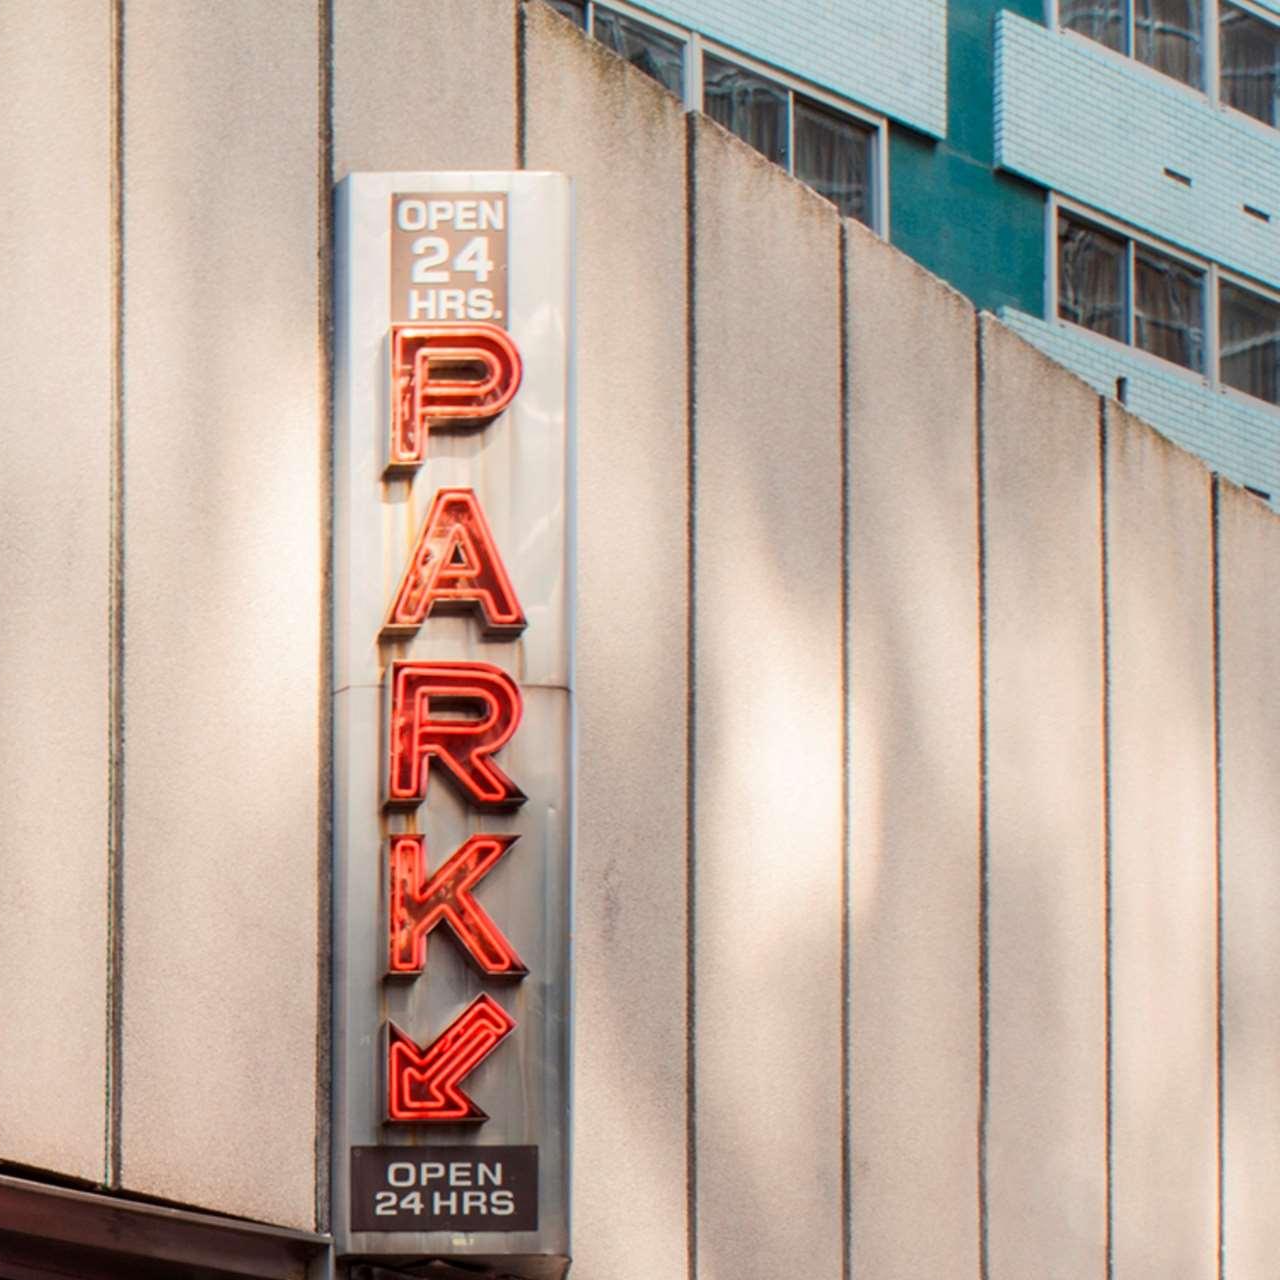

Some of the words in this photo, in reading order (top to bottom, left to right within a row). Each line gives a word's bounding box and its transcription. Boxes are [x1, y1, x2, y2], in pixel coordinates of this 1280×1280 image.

[398, 199, 503, 231] OPEN
[412, 236, 494, 283] 24
[408, 288, 502, 319] HRS.
[387, 322, 528, 977] PARK
[387, 1162, 502, 1187] OPEN
[375, 1191, 424, 1216] 24
[433, 1190, 515, 1216] HRS
